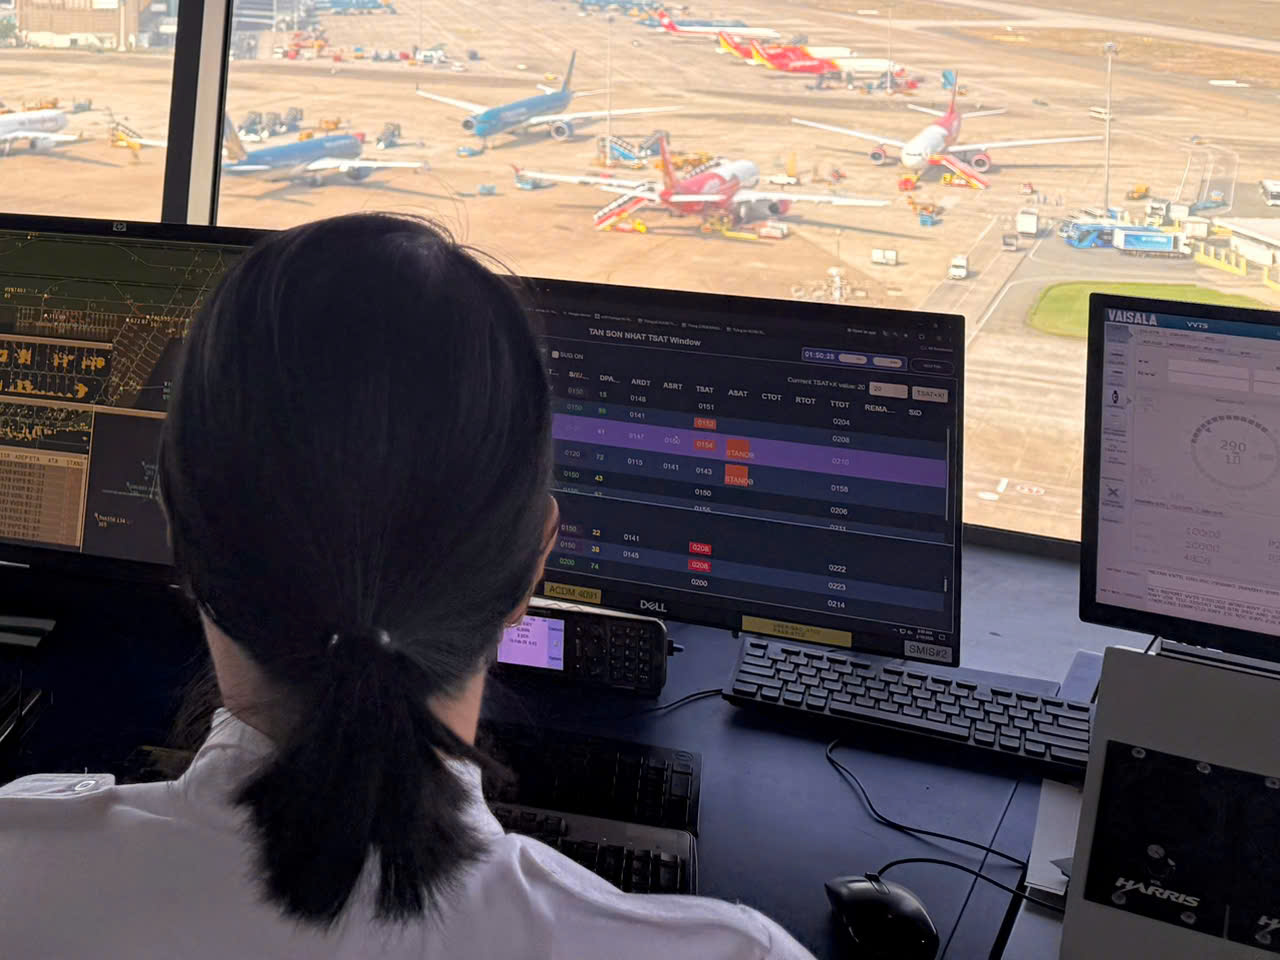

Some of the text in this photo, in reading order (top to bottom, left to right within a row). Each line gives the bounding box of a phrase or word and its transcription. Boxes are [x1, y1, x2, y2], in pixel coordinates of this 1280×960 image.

[1108, 309, 1158, 327] VAISALA
[1187, 321, 1209, 329] VVTS
[589, 327, 701, 347] TAN SON NHAT TSAT Window
[574, 352, 584, 360] ON
[787, 376, 812, 386] Current
[857, 383, 866, 391] 20
[631, 378, 651, 387] ARDT
[696, 385, 714, 394] TSAT
[728, 389, 749, 398] ASAT
[761, 392, 782, 402] CTOT
[795, 396, 817, 405] RTOT
[830, 400, 850, 409] TTOT
[629, 410, 646, 420] 0141
[698, 402, 715, 411] 0151
[832, 417, 850, 426] 0204
[1219, 439, 1247, 453] 290
[48, 456, 59, 464] ATA
[663, 462, 680, 472] 0141
[832, 457, 850, 467] 0210
[694, 488, 712, 498] 0150
[623, 533, 640, 542] 0141
[828, 563, 847, 573] 0222
[559, 557, 575, 567] 0200
[690, 578, 708, 587] 0200
[827, 599, 846, 609] 0214
[828, 582, 847, 592] 0223
[549, 584, 598, 601] ACDM 4091
[640, 599, 667, 613] DELL
[909, 644, 948, 659] SMIS#2
[1114, 876, 1201, 908] HARRIS
